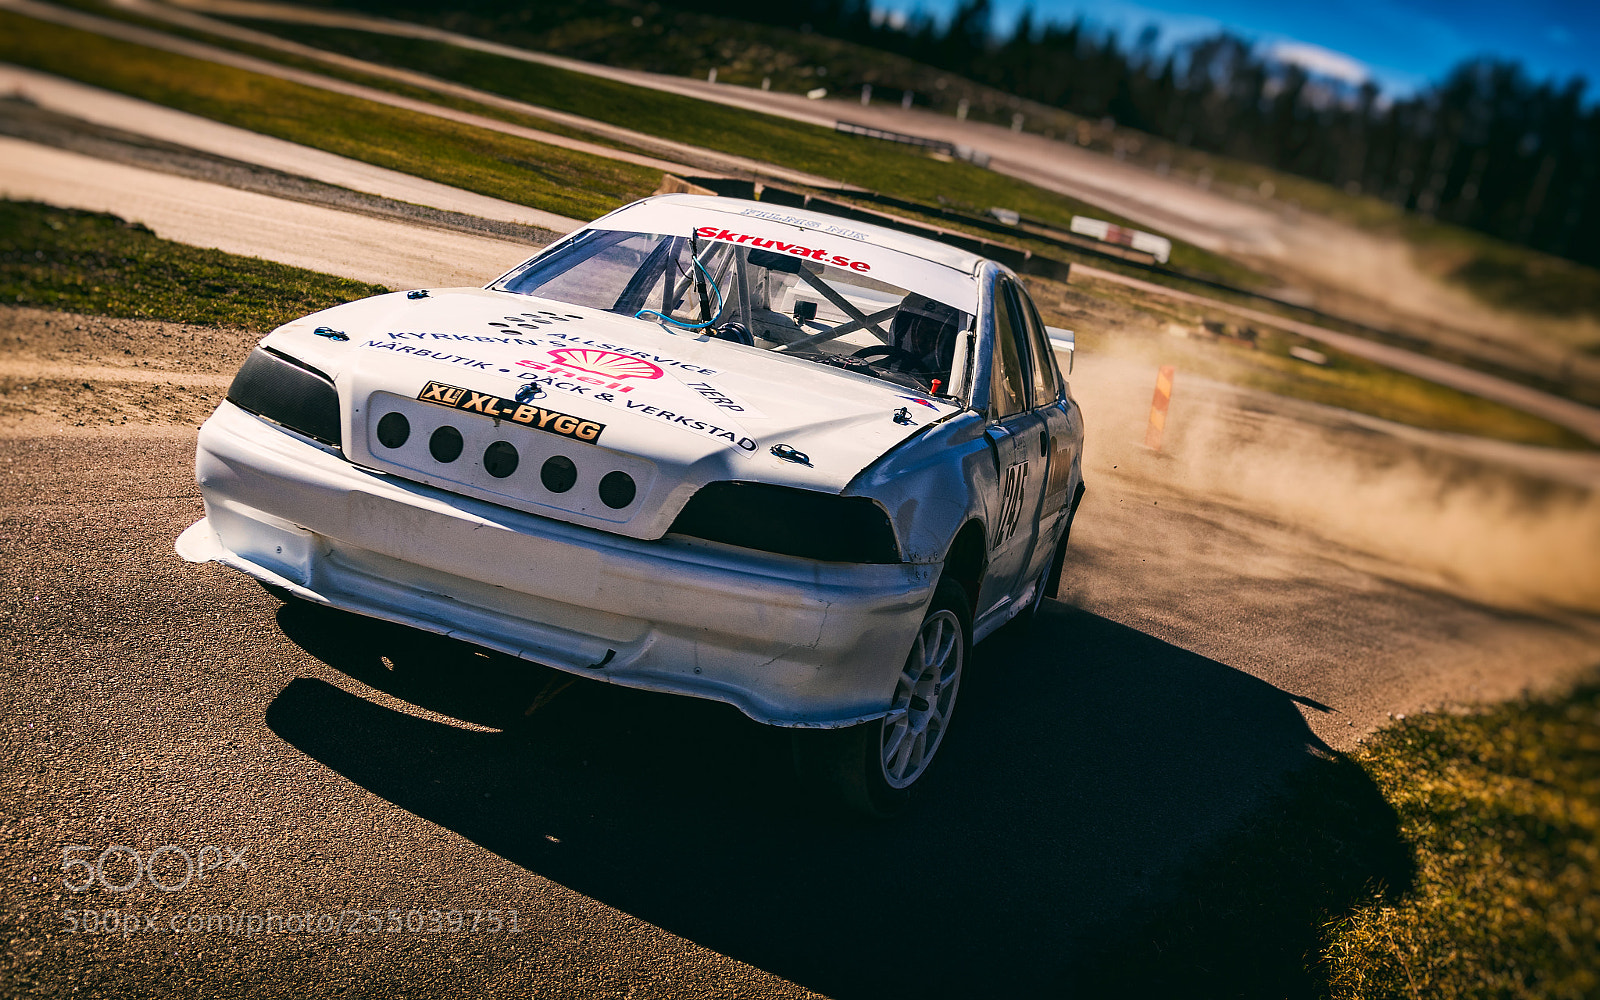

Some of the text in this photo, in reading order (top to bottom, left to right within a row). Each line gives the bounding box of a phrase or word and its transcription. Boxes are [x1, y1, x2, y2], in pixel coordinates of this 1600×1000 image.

[696, 226, 871, 273] Skruvat.se
[360, 340, 758, 452] NÄRBUTIK DÄCK & VERKSTAD
[423, 384, 457, 403] XL
[515, 359, 635, 393] Shell
[547, 333, 718, 376] ALLSERVICE
[688, 382, 745, 413] TIERP
[462, 392, 601, 440] XL-BYGG
